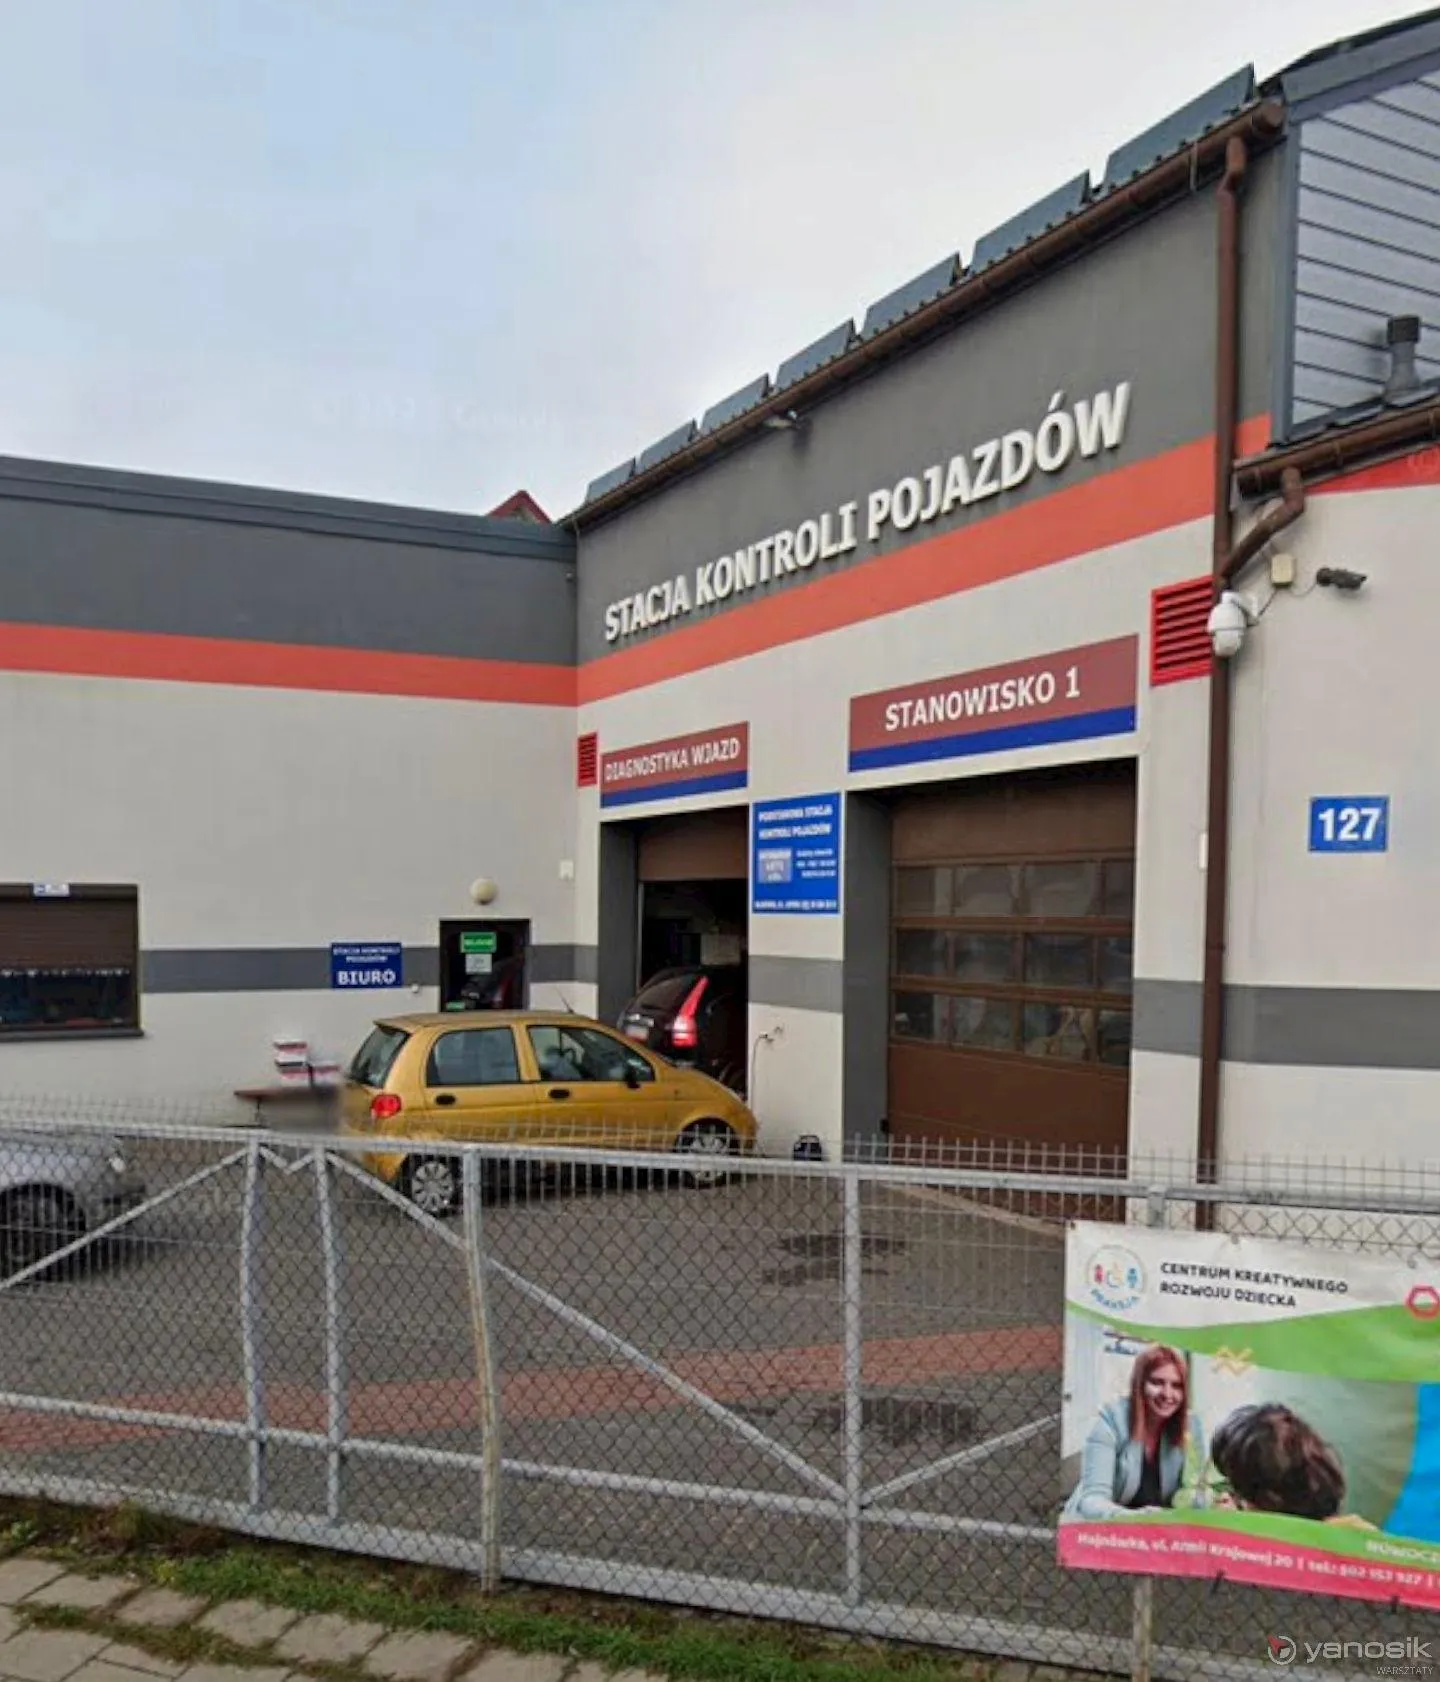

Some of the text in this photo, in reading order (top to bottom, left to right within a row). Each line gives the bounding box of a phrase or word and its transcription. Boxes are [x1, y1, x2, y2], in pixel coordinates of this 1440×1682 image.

[604, 382, 1130, 641] STACJA KONTROLI POJAZDÓW
[885, 666, 1081, 732] STANOWISKO 1
[605, 737, 741, 781] DIAGNOSTYKA WJAZD
[1318, 807, 1382, 842] 127
[337, 969, 396, 986] BIURO
[1160, 1261, 1349, 1294] CENTRUM KREATYWNEGO
[1160, 1281, 1231, 1300] ROZWOJU
[1234, 1290, 1297, 1308] DZIECKA
